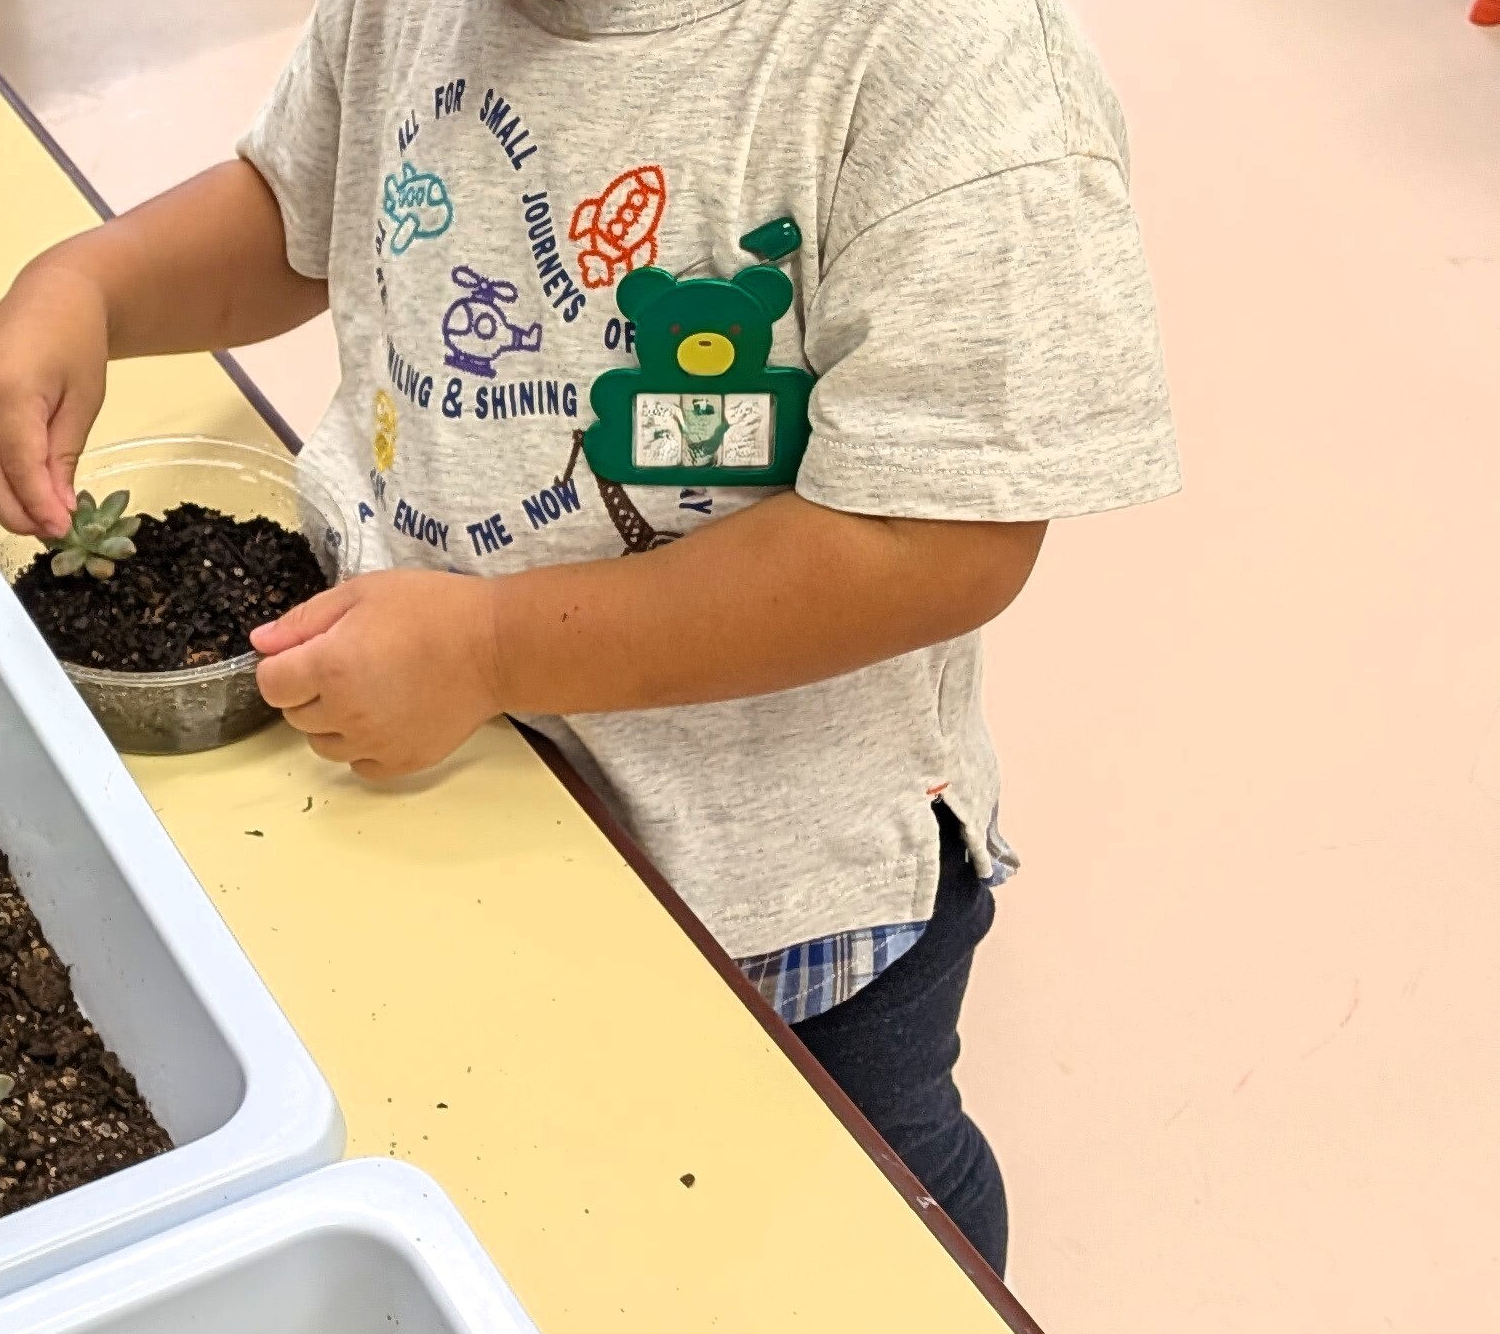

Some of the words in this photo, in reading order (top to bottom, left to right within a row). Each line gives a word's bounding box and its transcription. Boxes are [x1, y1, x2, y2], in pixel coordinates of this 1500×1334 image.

[398, 108, 419, 157] ALL
[435, 79, 465, 119] FOR
[480, 89, 538, 171] SMALL
[522, 191, 586, 323] JOURNEYS
[442, 377, 462, 419] &
[475, 380, 577, 420] SHINING
[393, 499, 449, 552] ENJOY
[466, 513, 513, 556] THE
[521, 478, 580, 530] NOW
